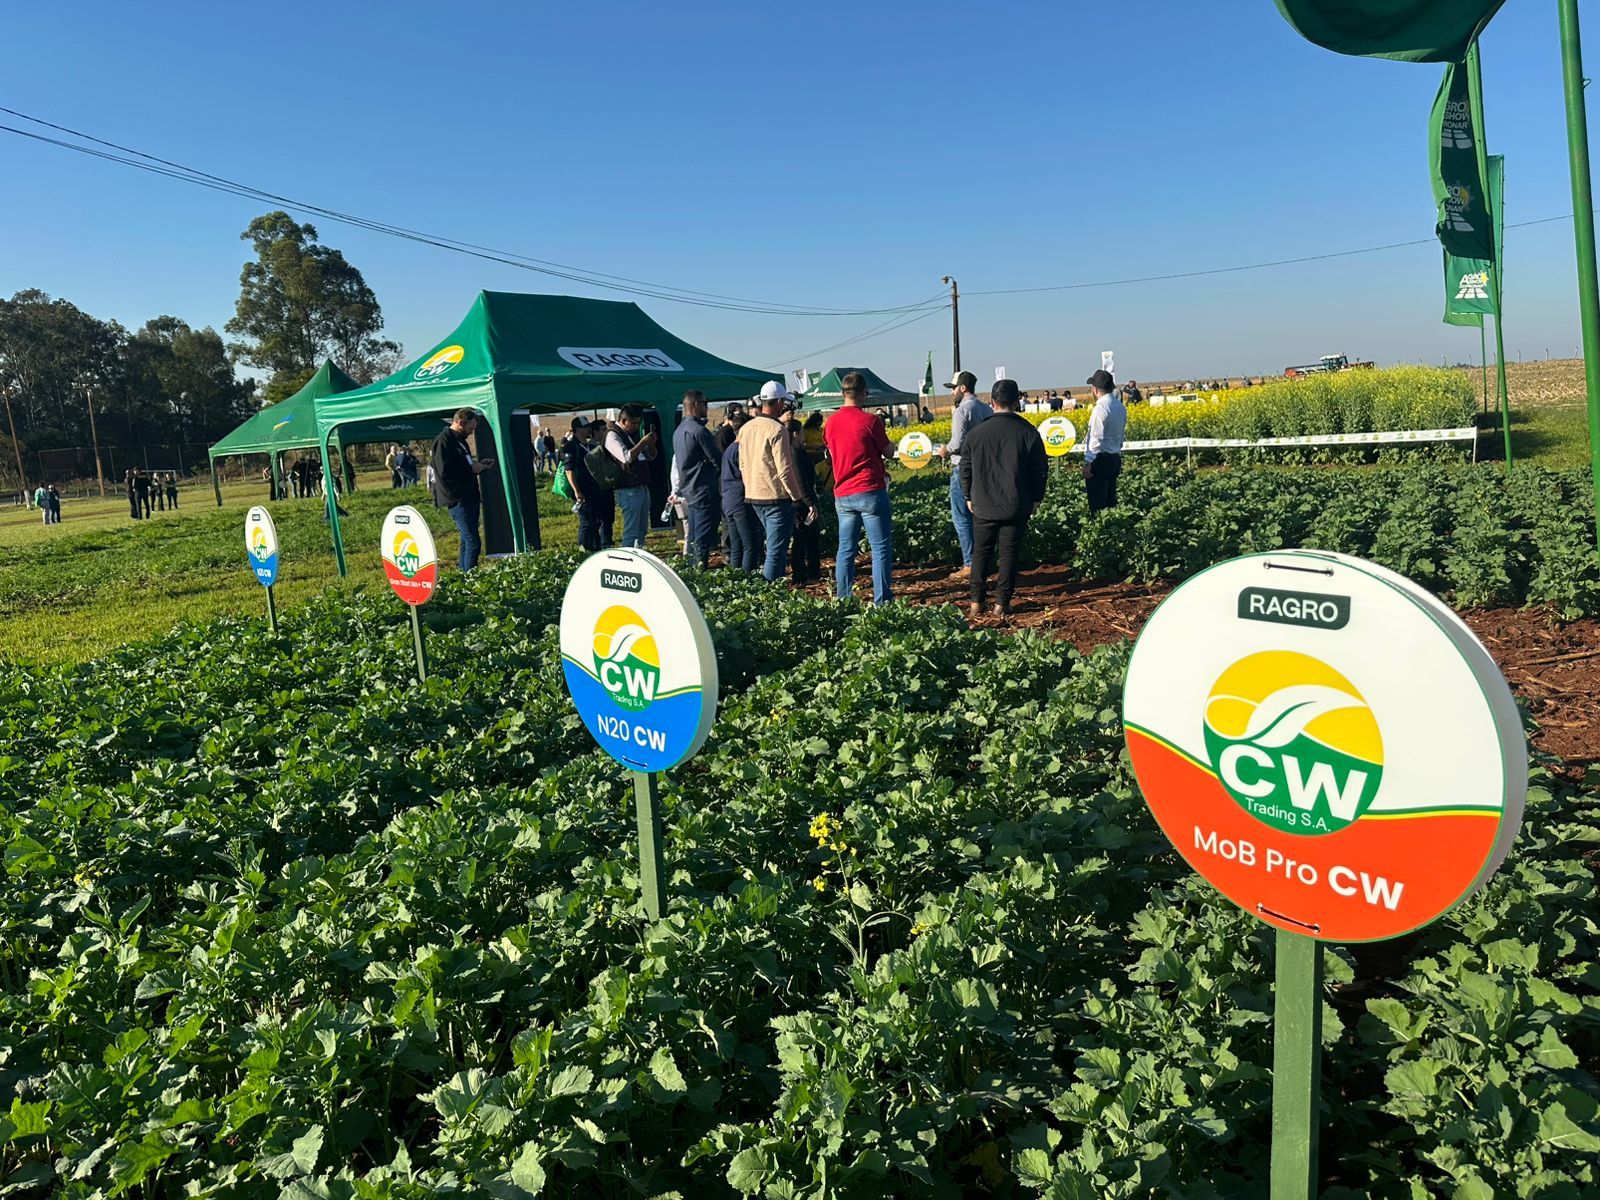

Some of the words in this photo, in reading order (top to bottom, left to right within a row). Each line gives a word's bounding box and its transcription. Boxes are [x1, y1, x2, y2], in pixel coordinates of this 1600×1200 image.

[571, 353, 669, 368] RAGRO
[417, 364, 449, 376] CW
[255, 547, 268, 559] CW
[396, 557, 418, 571] CW
[422, 581, 432, 589] CW
[604, 572, 638, 588] RAGRO
[1249, 594, 1339, 623] RAGRO
[601, 661, 655, 701] CW
[612, 693, 632, 707] Trading
[597, 714, 630, 741] N20
[633, 726, 666, 752] CW
[1219, 744, 1368, 821] CW
[1245, 797, 1296, 825] Trading
[1300, 813, 1332, 832] S.A.
[1193, 825, 1256, 866] MoB
[1266, 847, 1318, 886] Pro
[1327, 864, 1405, 911] CW
